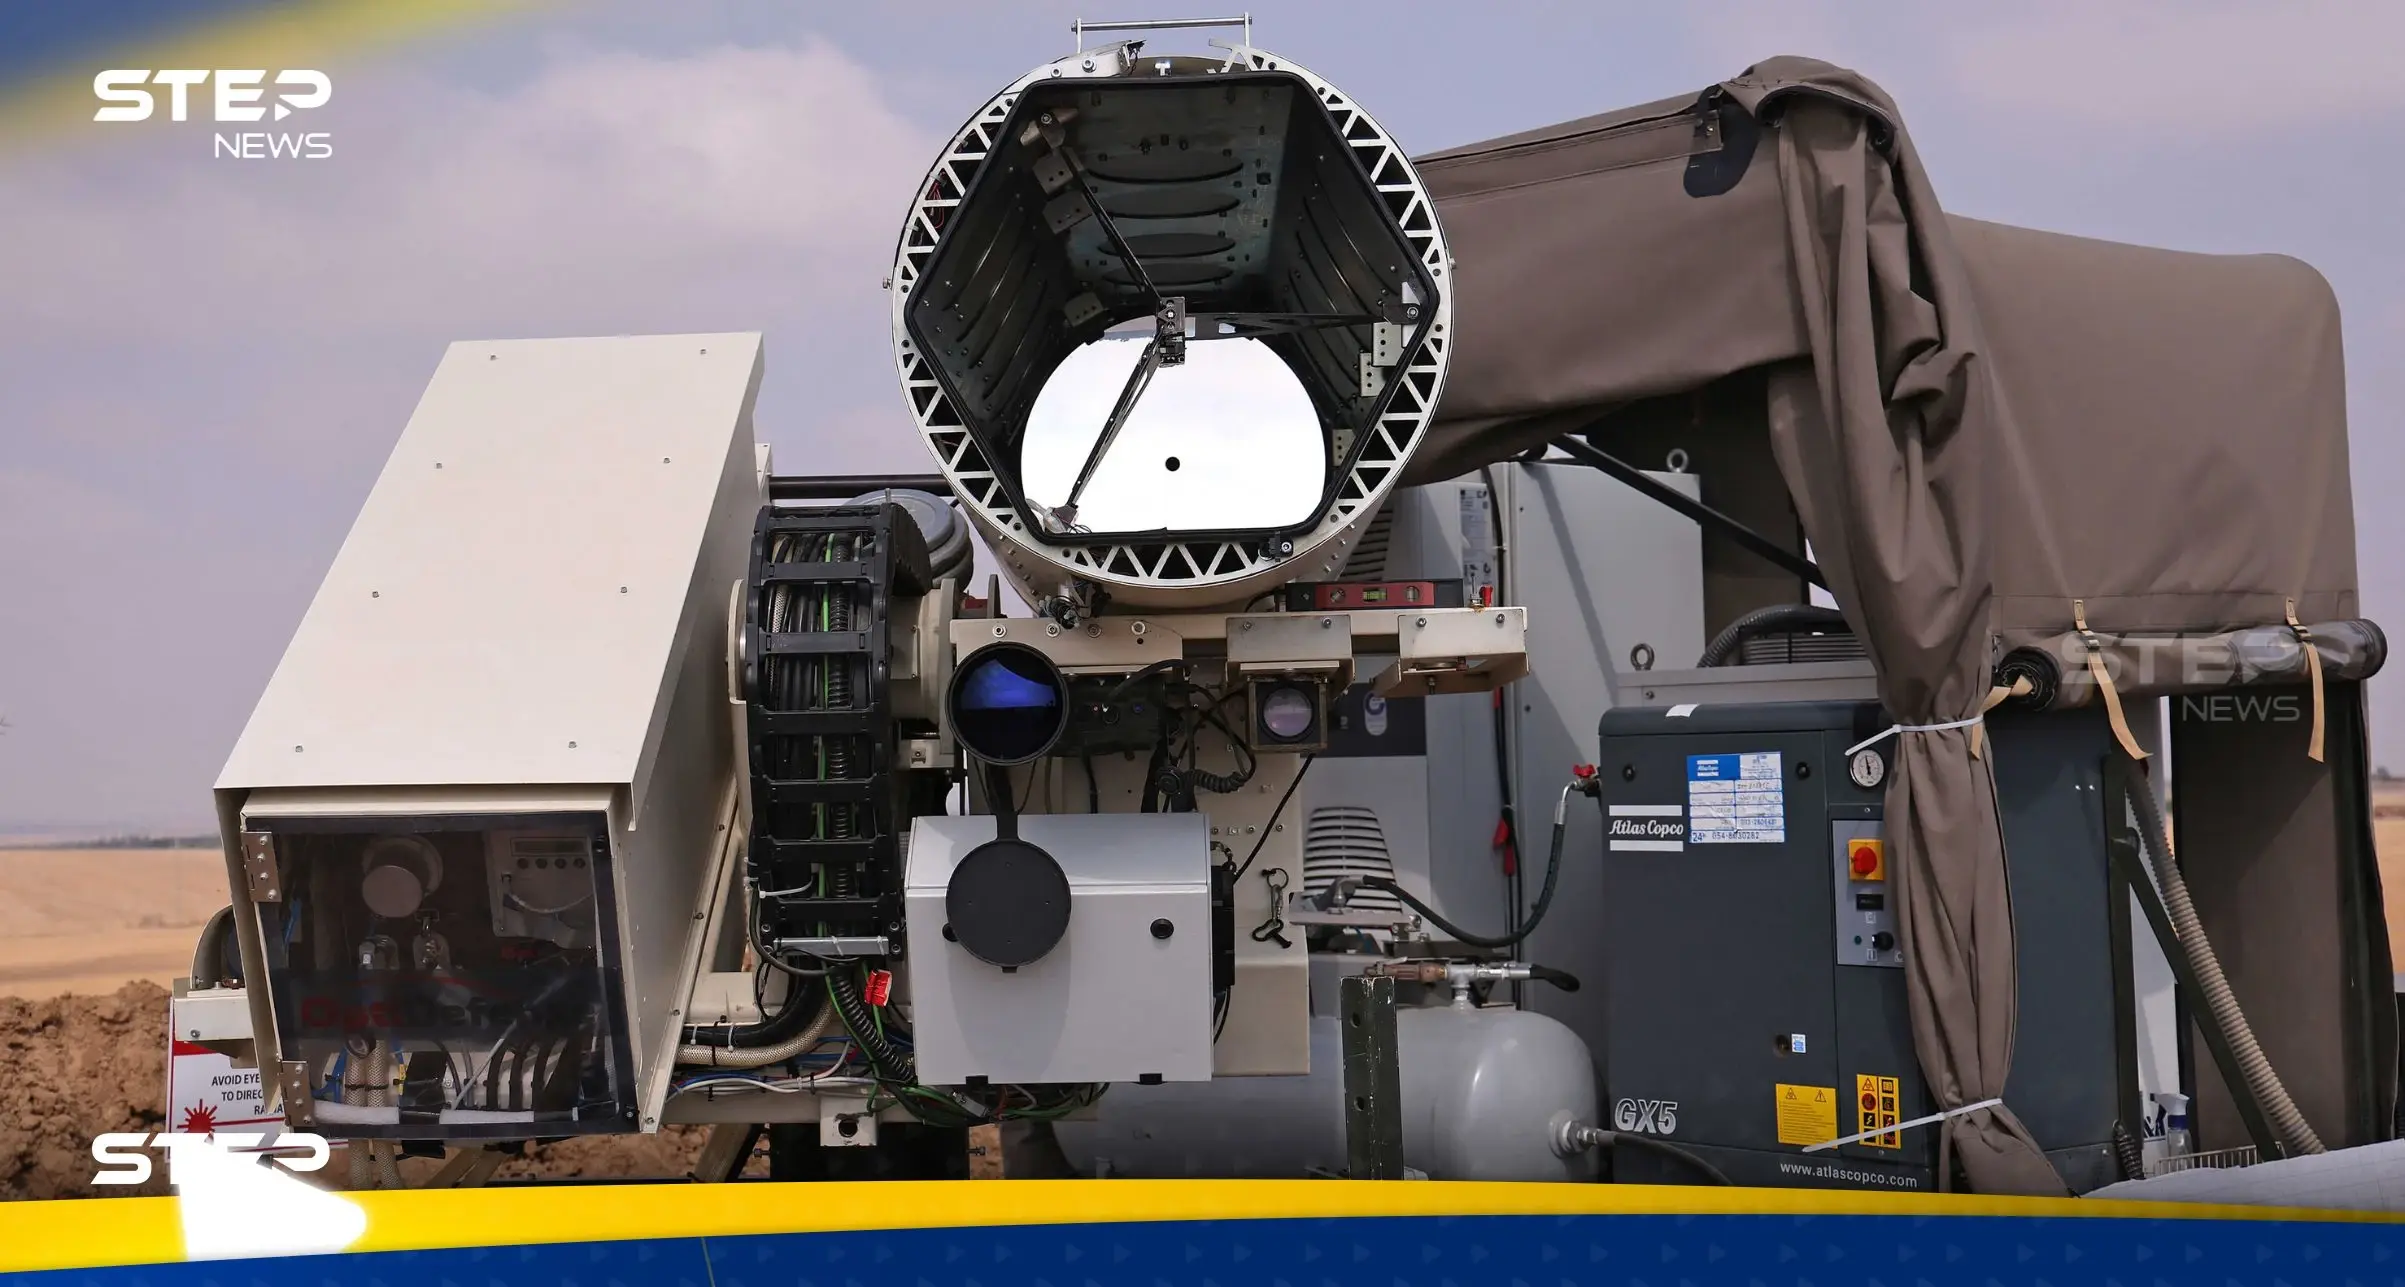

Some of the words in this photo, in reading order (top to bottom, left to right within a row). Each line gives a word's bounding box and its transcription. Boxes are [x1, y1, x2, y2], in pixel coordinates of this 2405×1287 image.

[1608, 819, 1647, 835] Atlas
[1647, 819, 1684, 838] Copco
[211, 1075, 242, 1086] AVOID
[243, 1073, 260, 1084] EYE
[221, 1091, 234, 1101] TO
[1614, 1098, 1678, 1135] GX5
[1780, 1163, 1918, 1188] www.atlascopco.com
